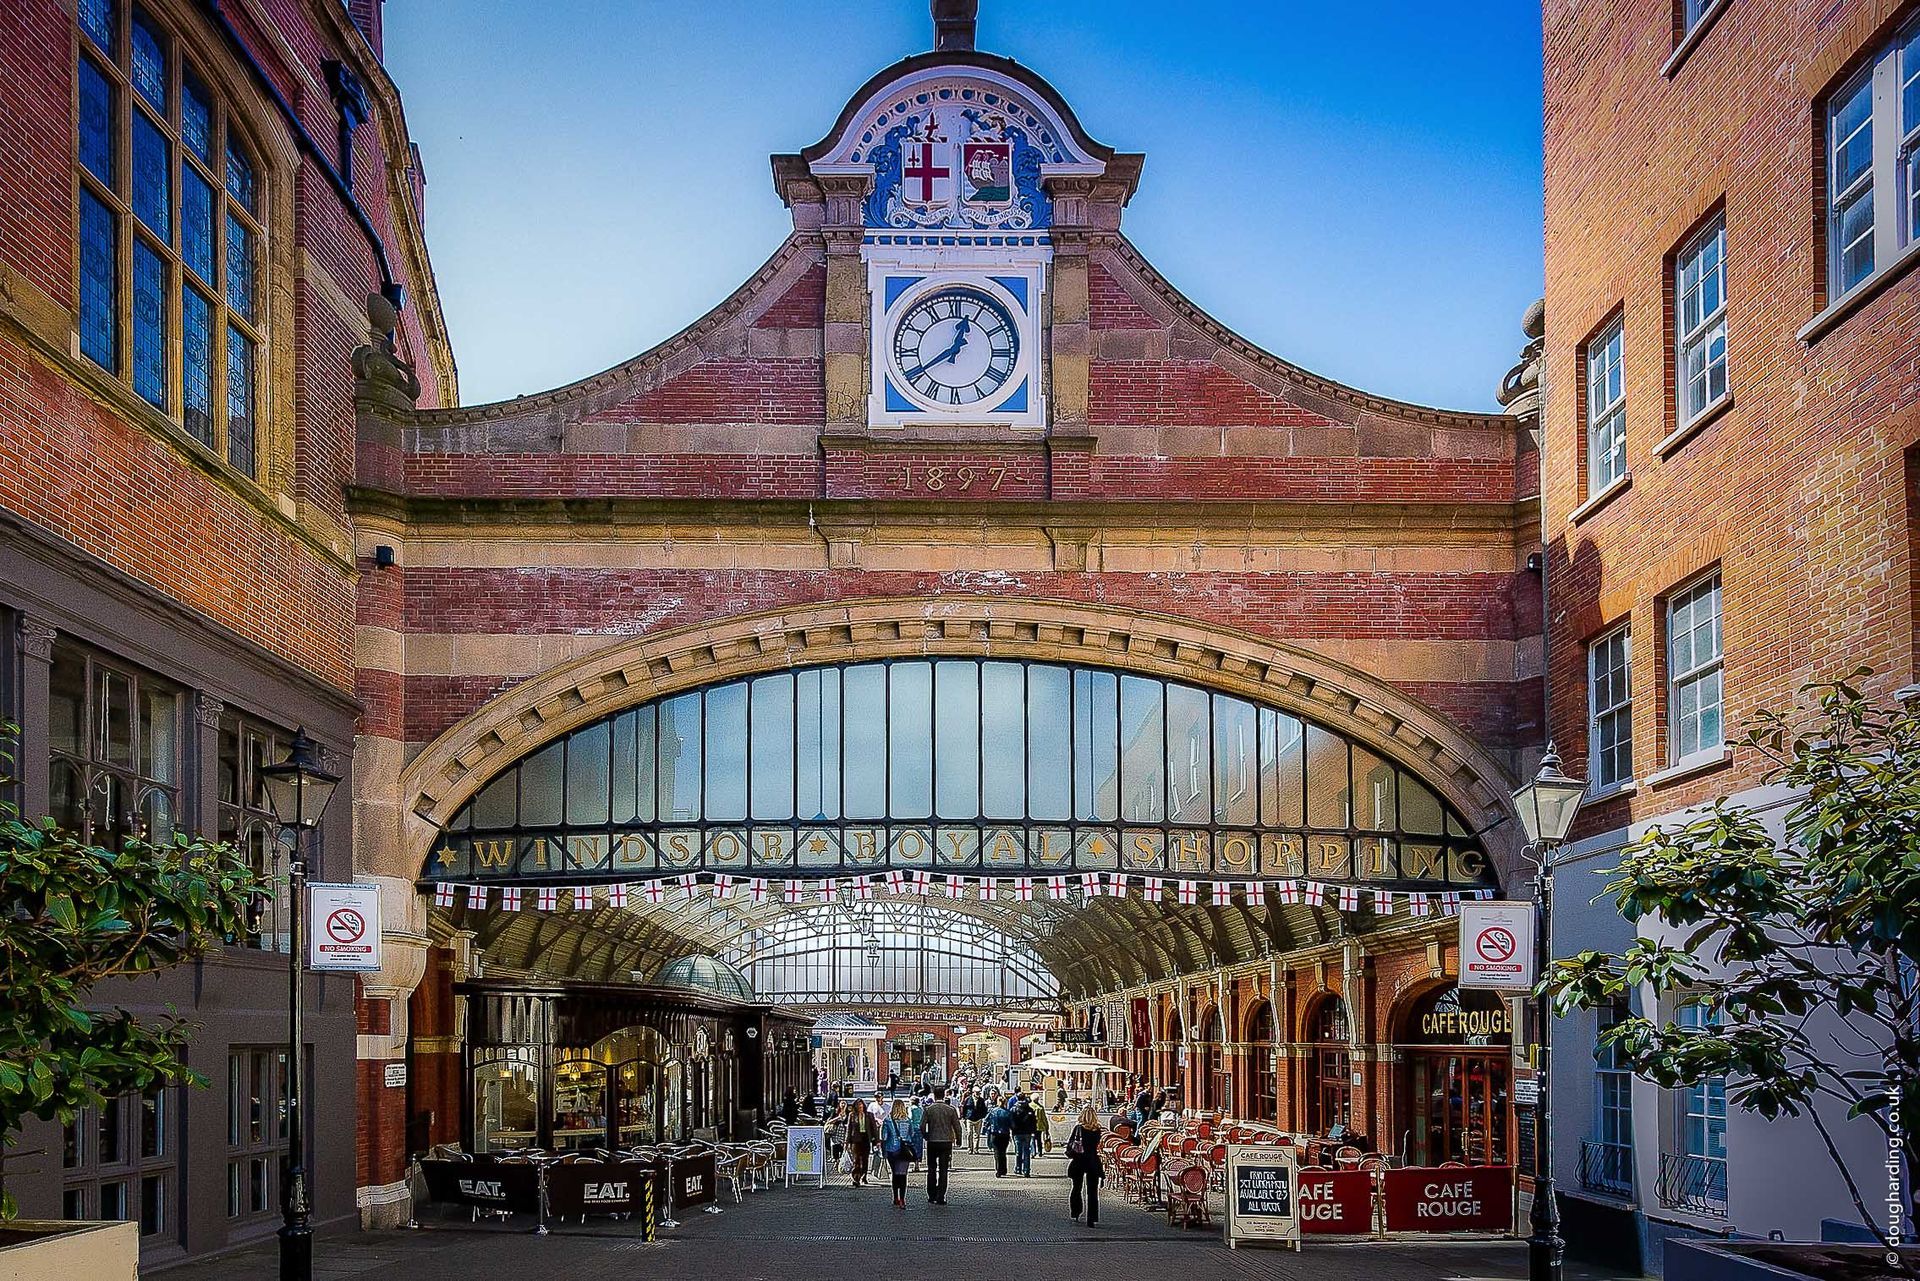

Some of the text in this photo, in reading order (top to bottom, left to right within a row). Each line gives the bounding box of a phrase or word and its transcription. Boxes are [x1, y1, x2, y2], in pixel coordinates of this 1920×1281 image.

[474, 831, 1486, 878] WINDSOR ROYAL SHOPPING
[336, 945, 367, 953] SMOKING
[1486, 964, 1517, 973] SMOKING
[1459, 1009, 1513, 1034] ROUGE
[1298, 1181, 1334, 1200] AFÉ
[1424, 1181, 1473, 1199] CAFÉ
[1302, 1203, 1343, 1220] UGE
[1417, 1201, 1482, 1217] ROUGE
